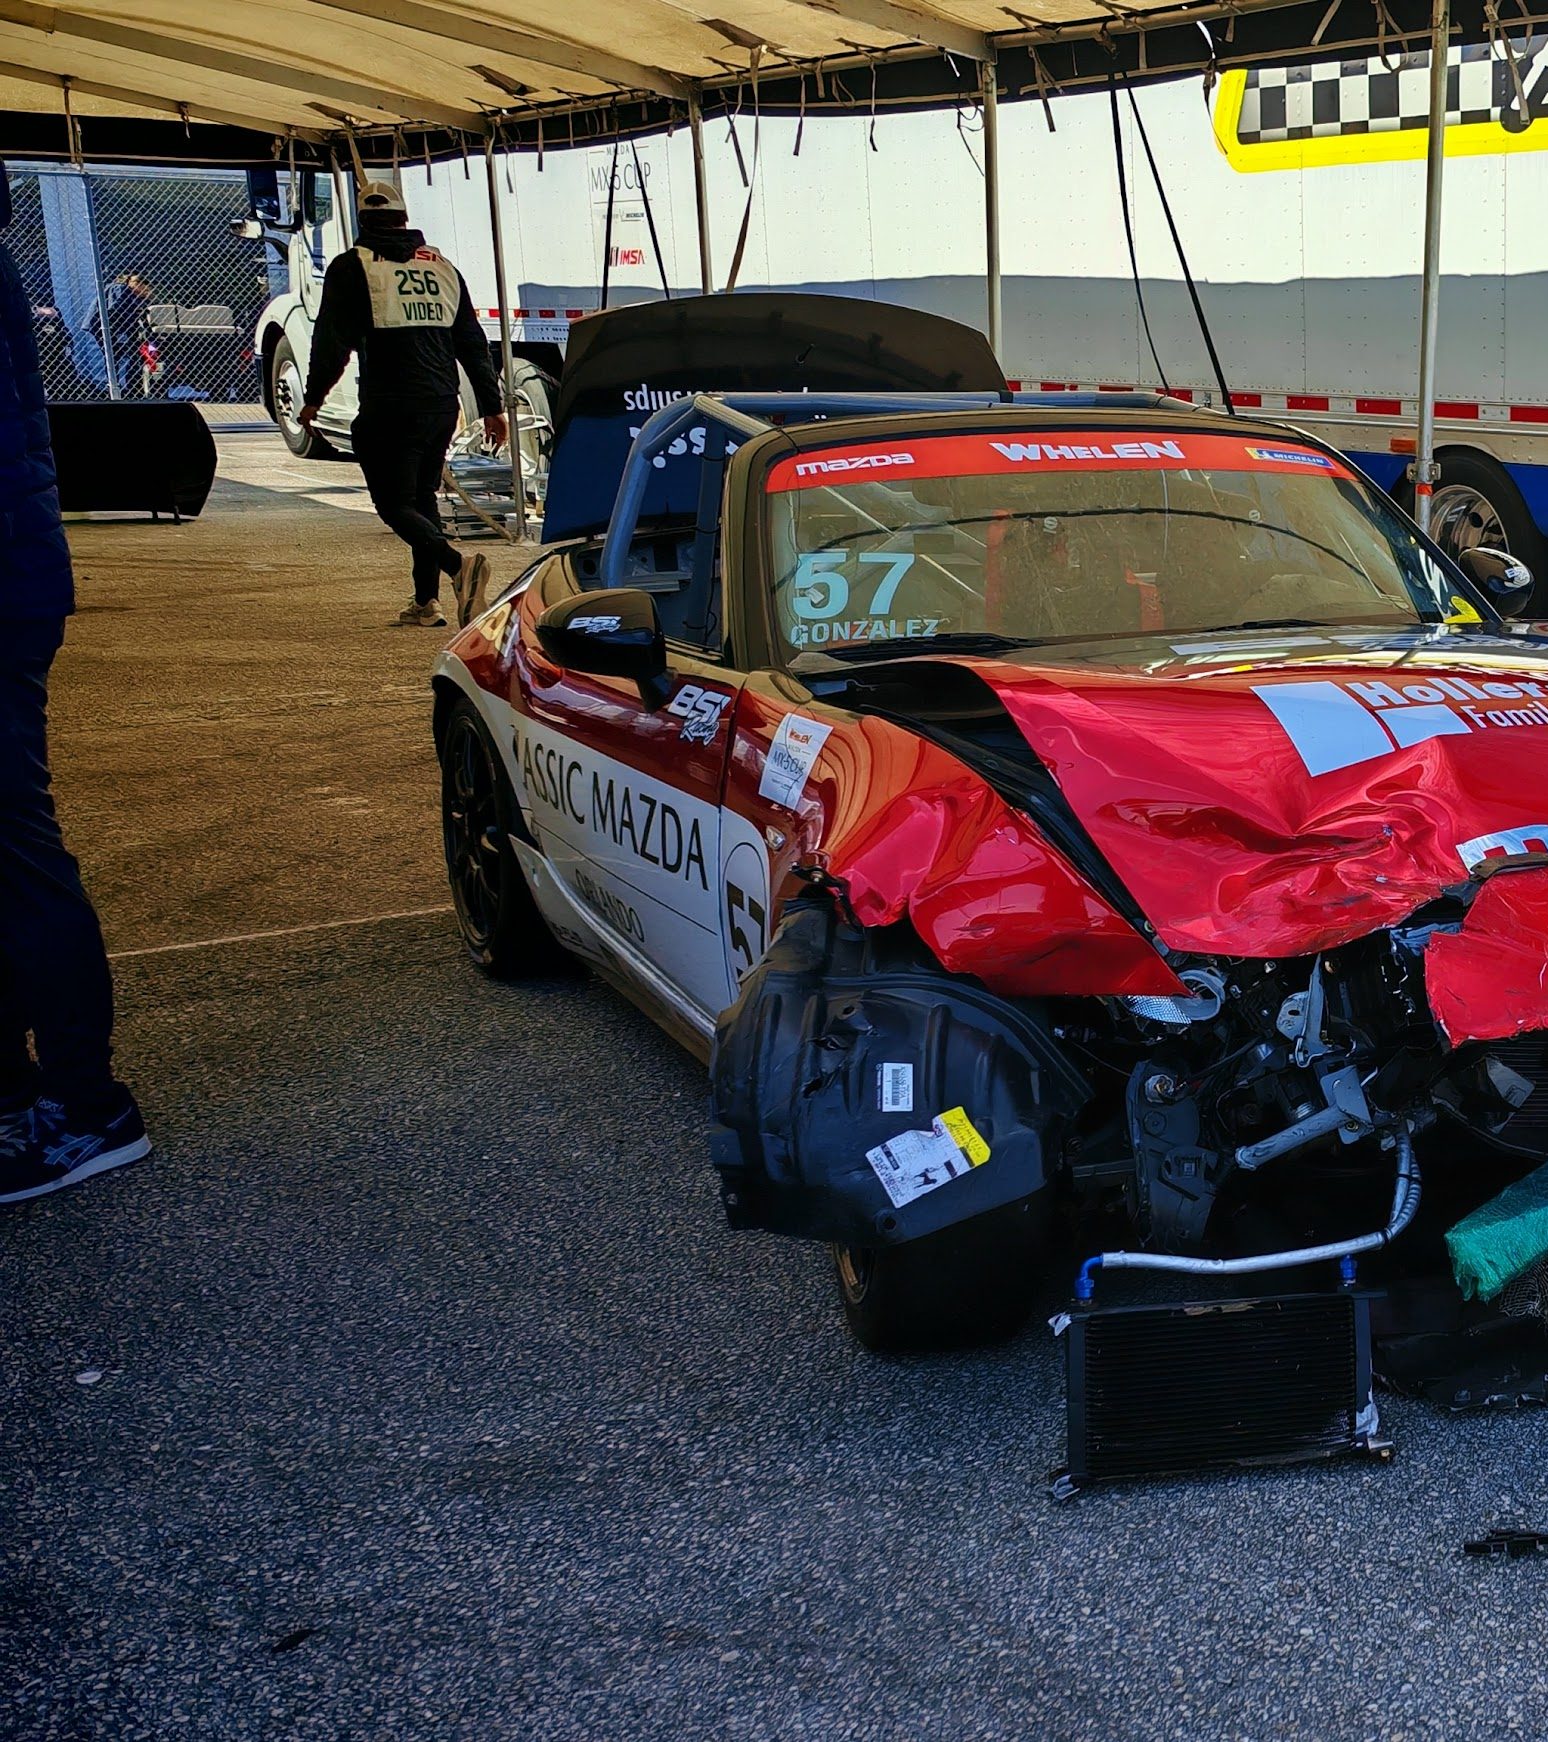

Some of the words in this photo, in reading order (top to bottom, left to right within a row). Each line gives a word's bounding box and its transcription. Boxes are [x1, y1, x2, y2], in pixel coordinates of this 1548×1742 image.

[395, 269, 440, 296] 256
[402, 302, 443, 321] VIDEO
[988, 441, 1185, 461] WHELEN
[1273, 453, 1324, 464] MICHELIN
[792, 551, 916, 620] 57
[790, 619, 940, 647] GONZALEZ
[592, 771, 709, 891] MAZDA
[726, 880, 766, 978] 57
